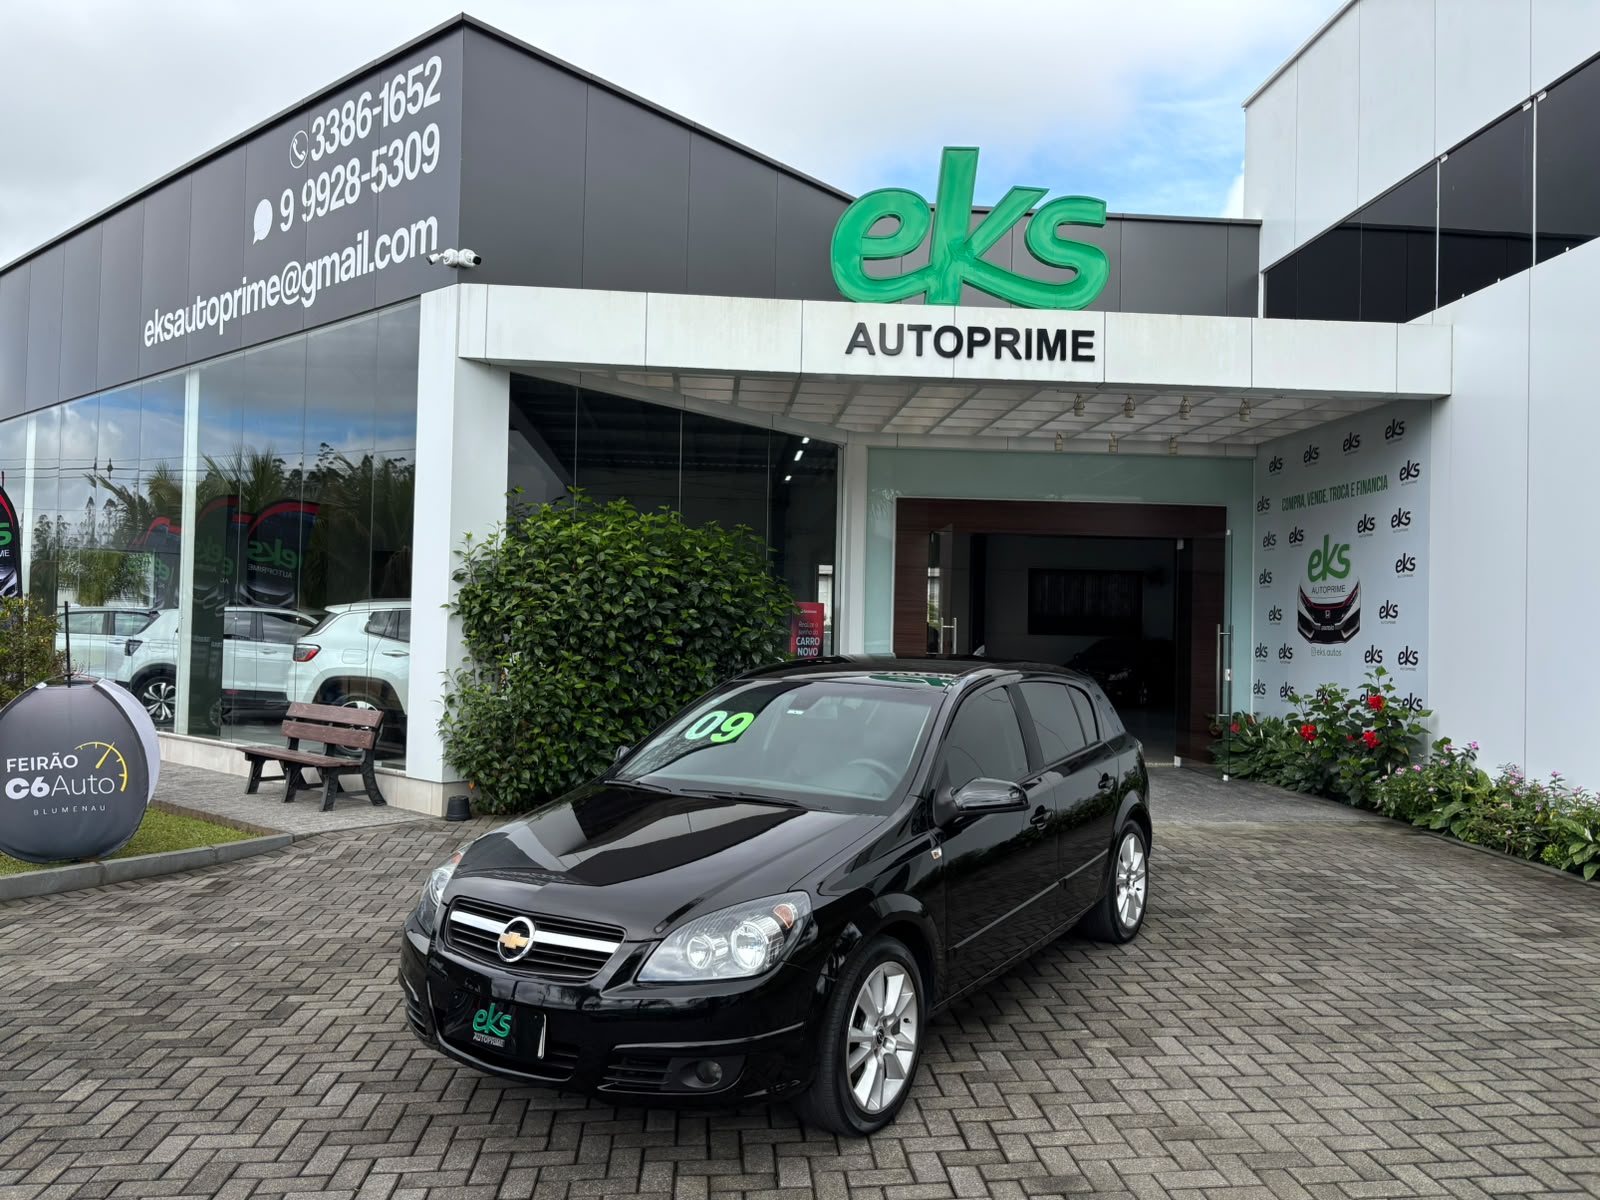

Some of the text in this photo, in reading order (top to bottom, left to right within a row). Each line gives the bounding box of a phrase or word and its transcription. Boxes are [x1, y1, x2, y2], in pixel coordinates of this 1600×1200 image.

[310, 55, 443, 161] 3386-1652
[280, 123, 441, 232] 9 9928-5309
[830, 146, 1111, 311] eks
[144, 216, 438, 347] eksautoprime@gmail.com
[845, 322, 1096, 362] AUTOPRIME
[1385, 418, 1405, 440] eks
[1343, 432, 1360, 452] eks
[1303, 445, 1320, 463] eks
[1269, 456, 1283, 473] eks
[1399, 460, 1420, 481] eks
[1329, 483, 1349, 502] TROCA
[1350, 482, 1356, 497] E
[1356, 475, 1388, 496] FINANCIA
[1357, 513, 1375, 534] eks
[1391, 507, 1411, 528] eks
[1263, 531, 1276, 547] eks
[1288, 526, 1304, 544] eks
[1308, 535, 1351, 583] eks
[1395, 553, 1416, 573] eks
[1259, 568, 1272, 584] eks
[1312, 585, 1346, 594] AUTOPRIME
[1268, 605, 1282, 621] eks
[1379, 600, 1398, 619] eks
[795, 637, 820, 646] CARRO
[1255, 643, 1268, 658] eks
[1278, 643, 1293, 660] eks
[797, 648, 819, 656] NOVO
[1364, 644, 1383, 664] eks
[1398, 646, 1419, 666] eks
[1253, 679, 1266, 695] eks
[685, 710, 755, 743] 09
[6, 752, 78, 772] FEIRÃO
[33, 805, 106, 815] BLUMENAU
[472, 1003, 513, 1038] eks
[473, 1031, 505, 1048] AUTOPRIME
